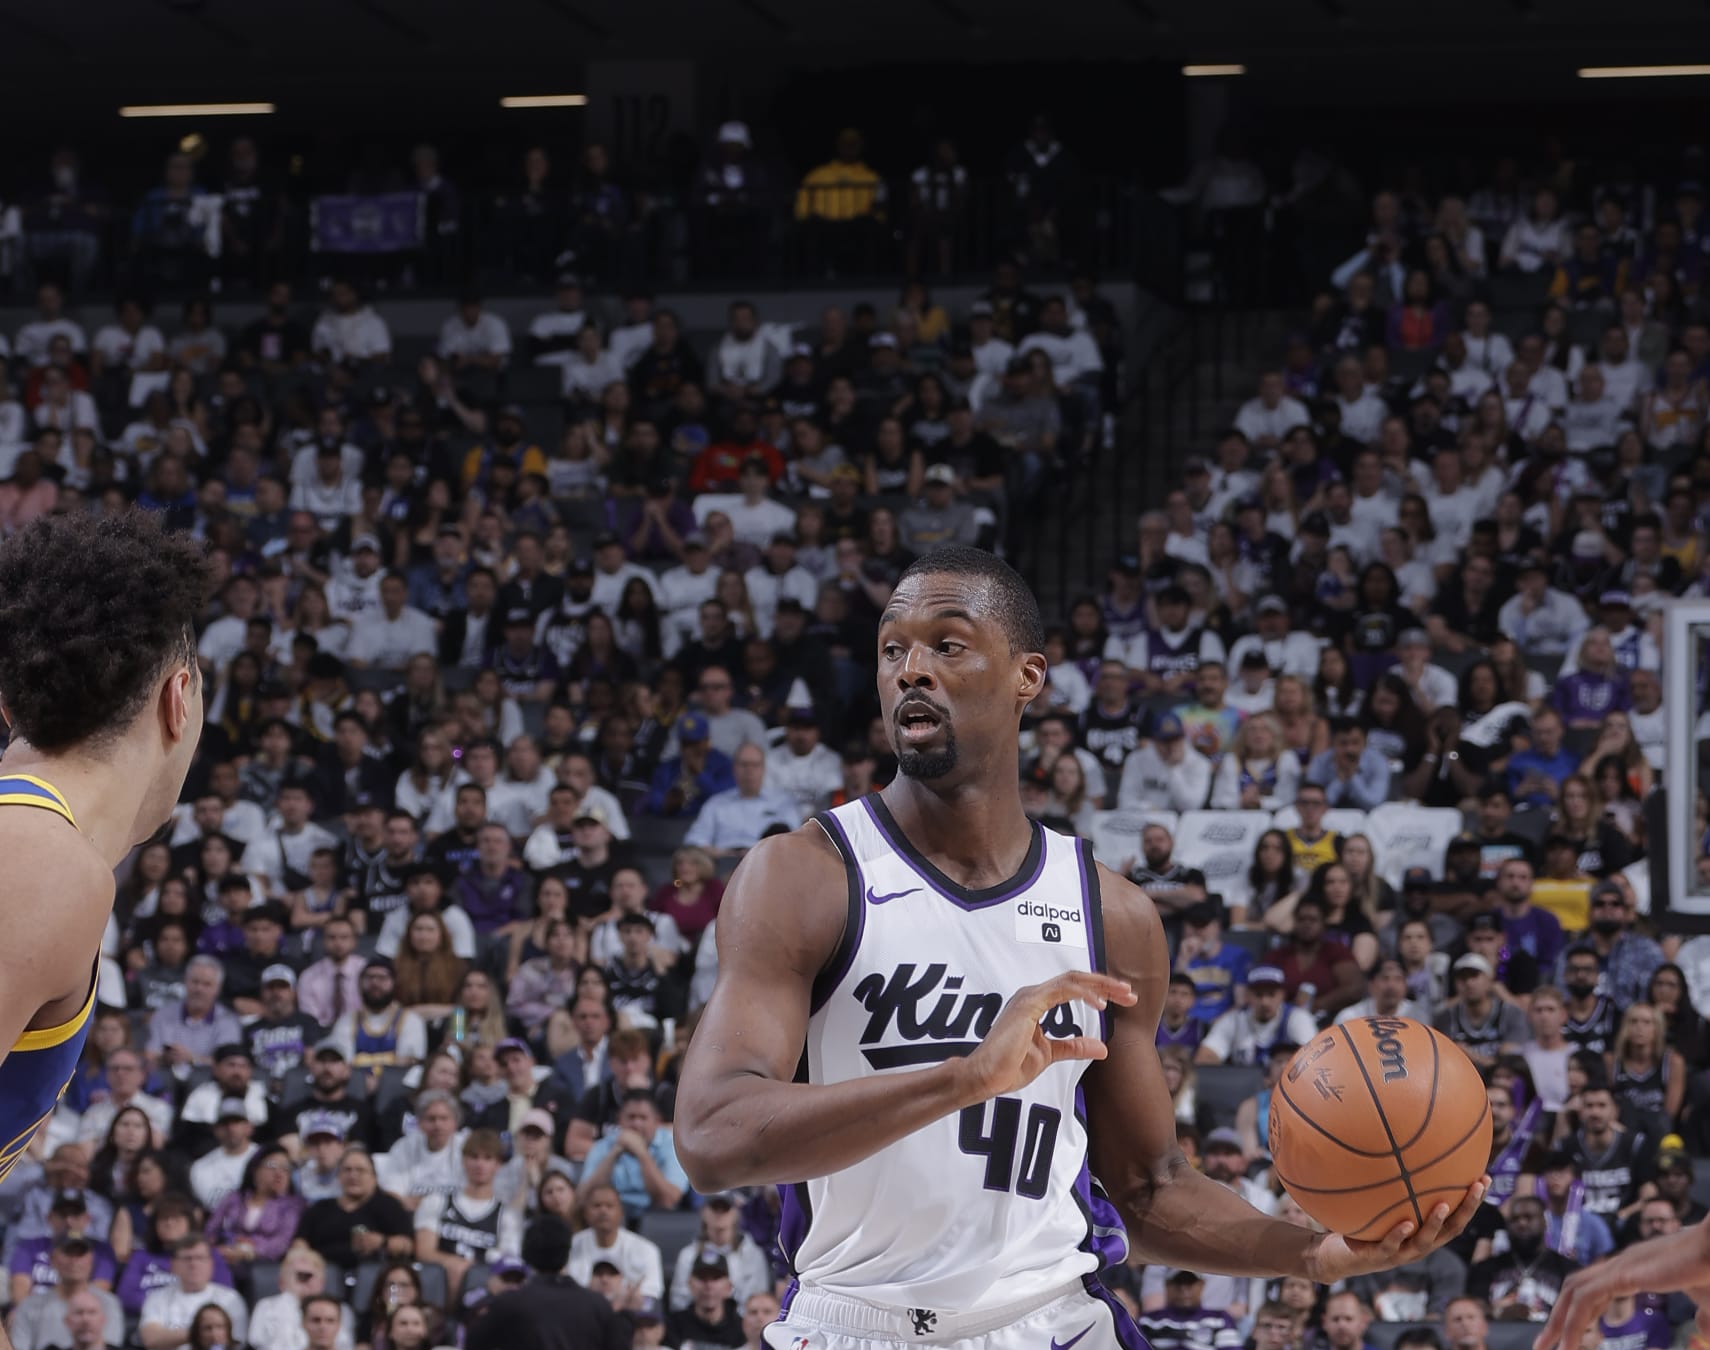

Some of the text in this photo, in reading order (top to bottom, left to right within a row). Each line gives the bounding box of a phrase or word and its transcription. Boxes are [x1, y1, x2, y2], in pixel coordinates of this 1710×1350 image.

[1017, 900, 1081, 922] dialpad
[853, 963, 1083, 1045] Kins
[958, 1097, 1062, 1200] 40
